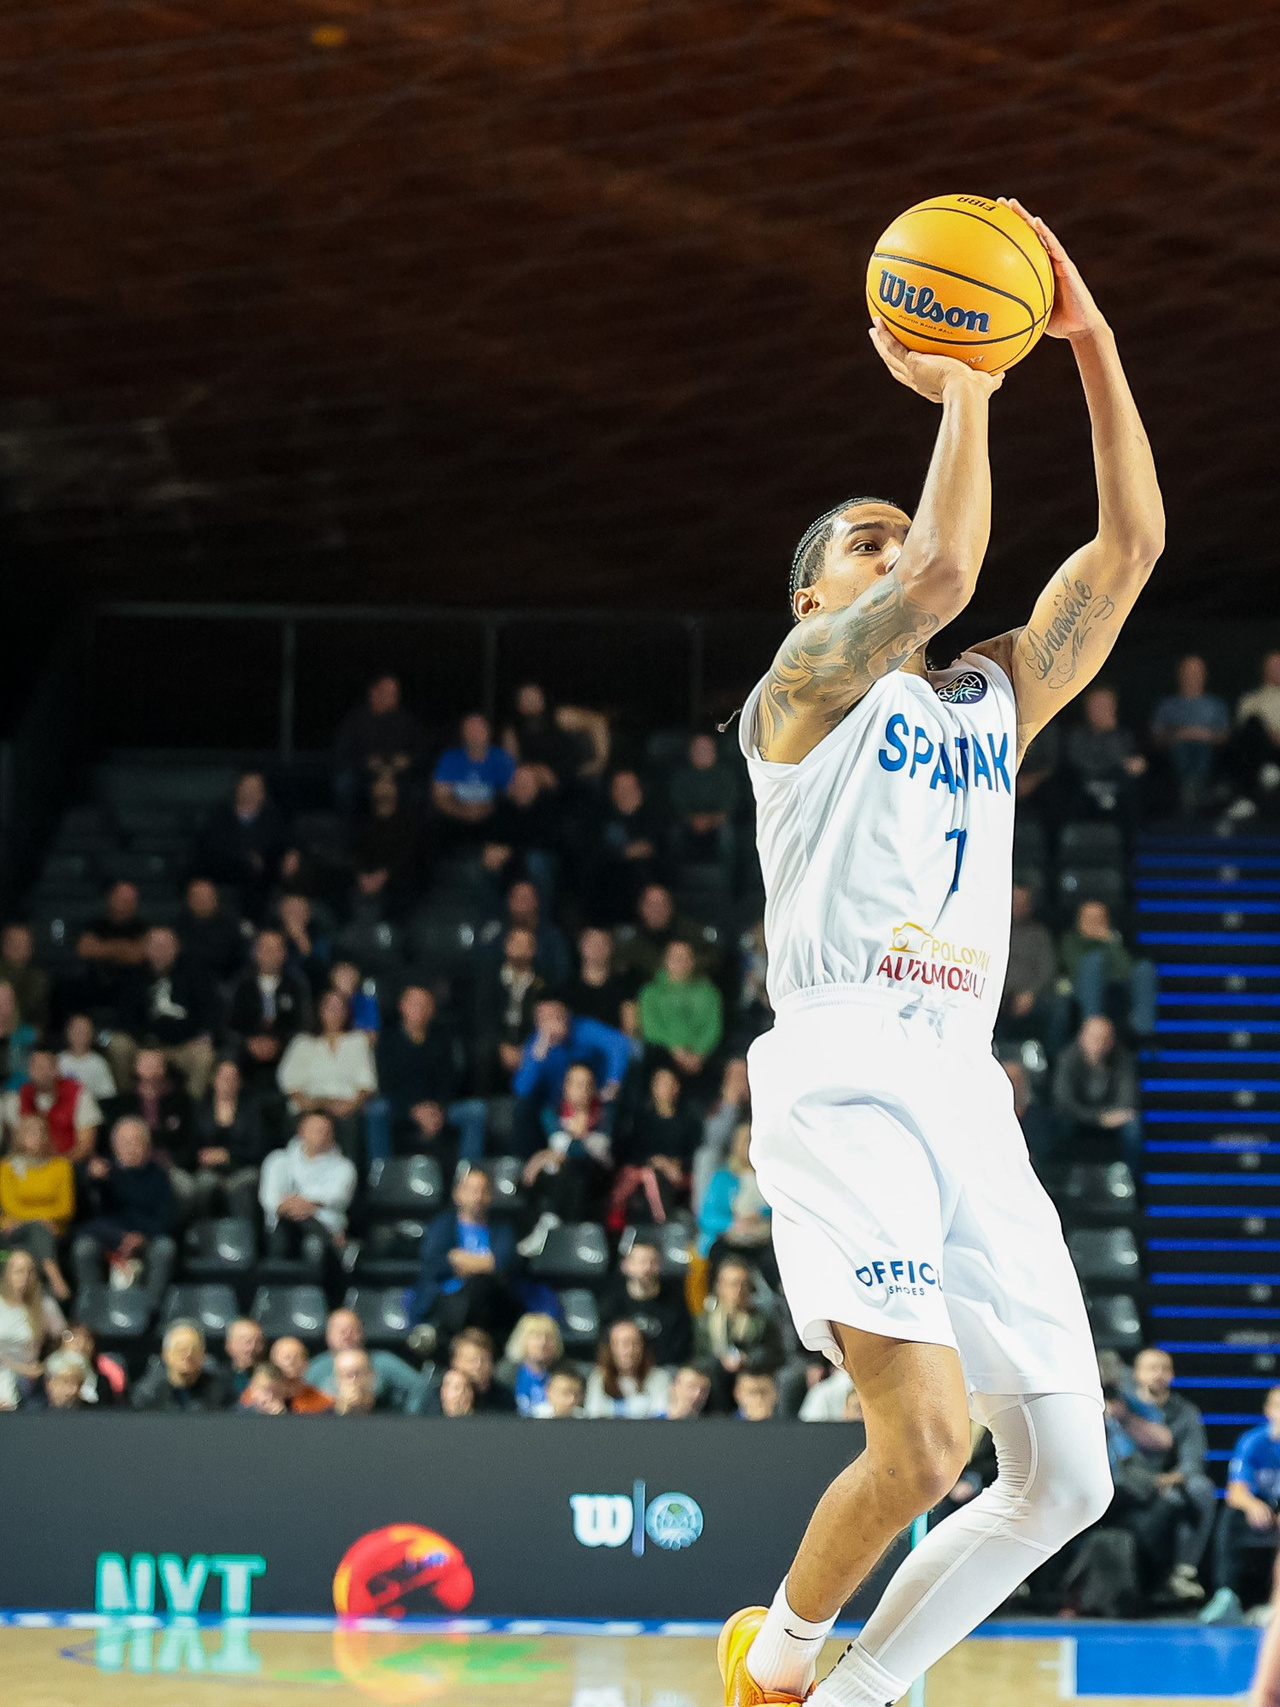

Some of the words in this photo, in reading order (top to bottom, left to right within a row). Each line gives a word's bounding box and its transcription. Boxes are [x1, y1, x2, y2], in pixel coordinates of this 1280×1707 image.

[879, 268, 990, 333] Wilson
[878, 713, 1011, 796] SPATAK
[945, 828, 967, 894] 7
[855, 1260, 943, 1292] OFFIC
[889, 1285, 925, 1295] SHOES
